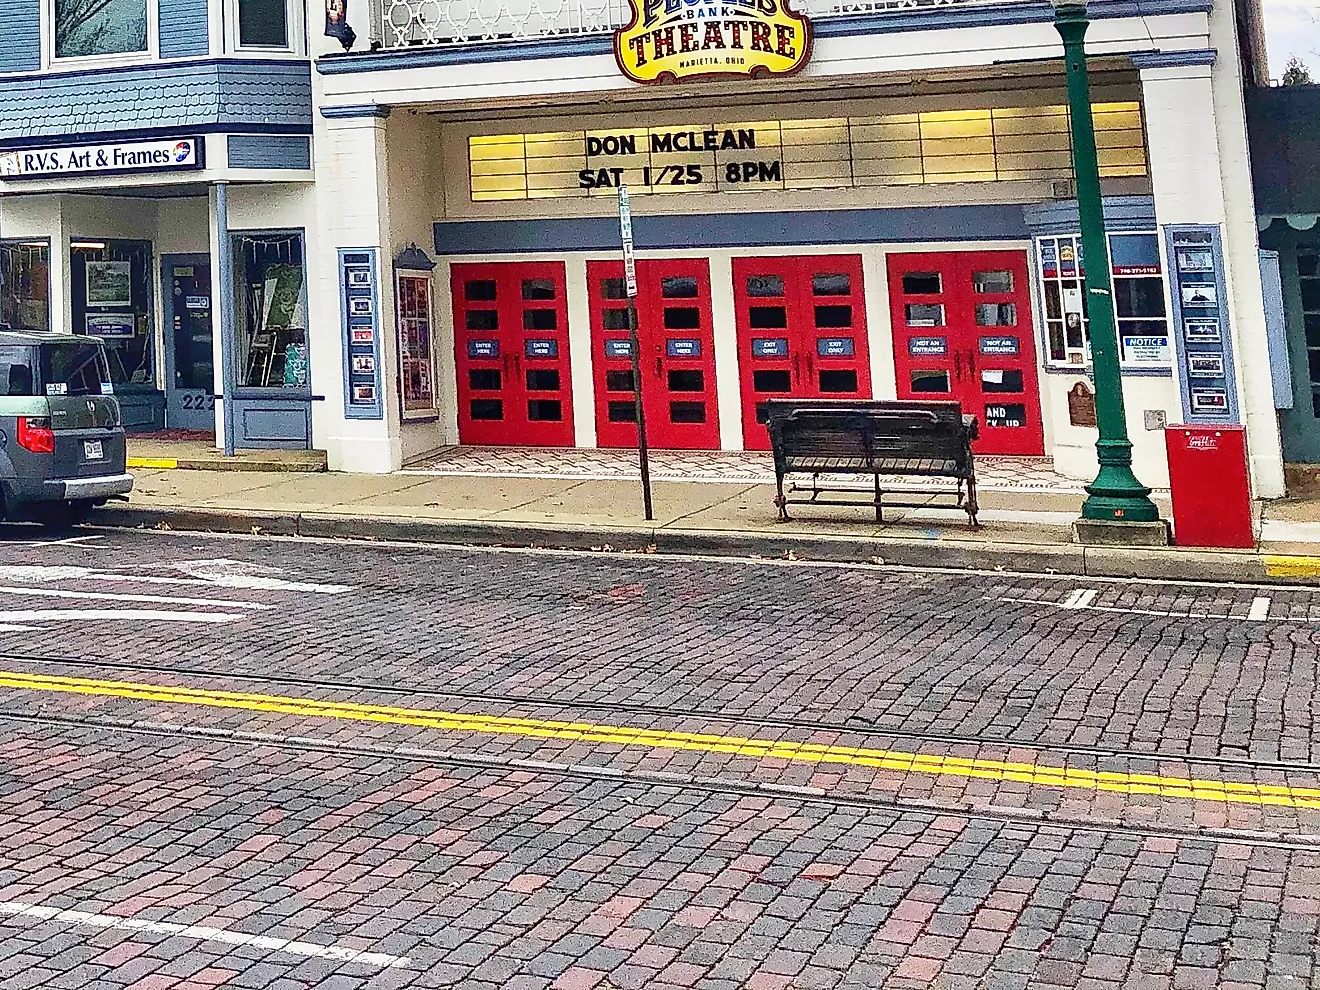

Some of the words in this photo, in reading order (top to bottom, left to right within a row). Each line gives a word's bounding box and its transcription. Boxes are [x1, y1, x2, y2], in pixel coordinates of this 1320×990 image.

[686, 6, 730, 19] BANK
[629, 20, 796, 68] THEATRE
[725, 57, 745, 65] OHIO
[587, 135, 636, 156] DON
[651, 129, 756, 152] MCLEAN
[24, 152, 63, 171] R.V.S.
[67, 150, 92, 169] Art
[95, 148, 109, 166] &
[113, 148, 170, 166] Frames
[579, 167, 624, 188] SAT
[643, 164, 703, 186] 1/25
[725, 161, 780, 183] 8PM
[986, 407, 1006, 417] AND
